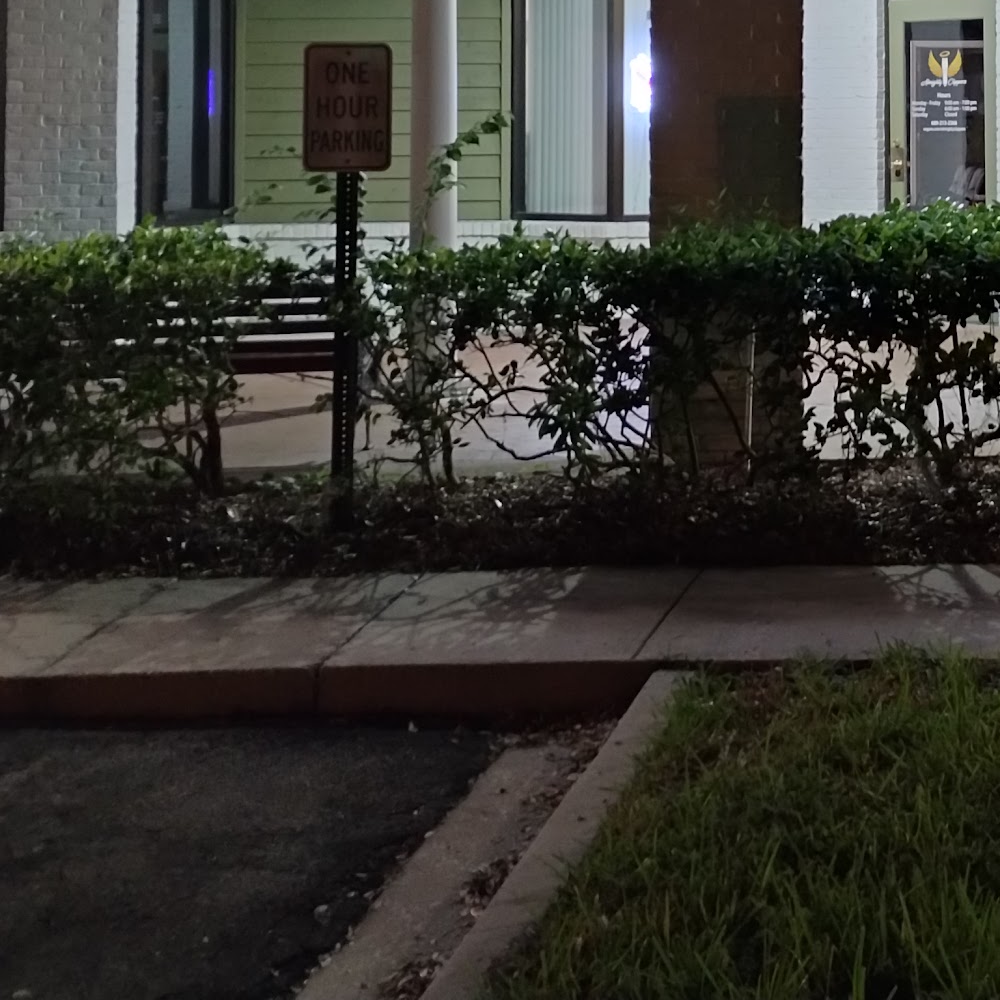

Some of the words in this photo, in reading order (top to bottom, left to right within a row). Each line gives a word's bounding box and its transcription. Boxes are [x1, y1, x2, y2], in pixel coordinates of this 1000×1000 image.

[325, 62, 371, 85] ONE
[316, 95, 379, 119] HOUR
[310, 129, 385, 153] PARKING
